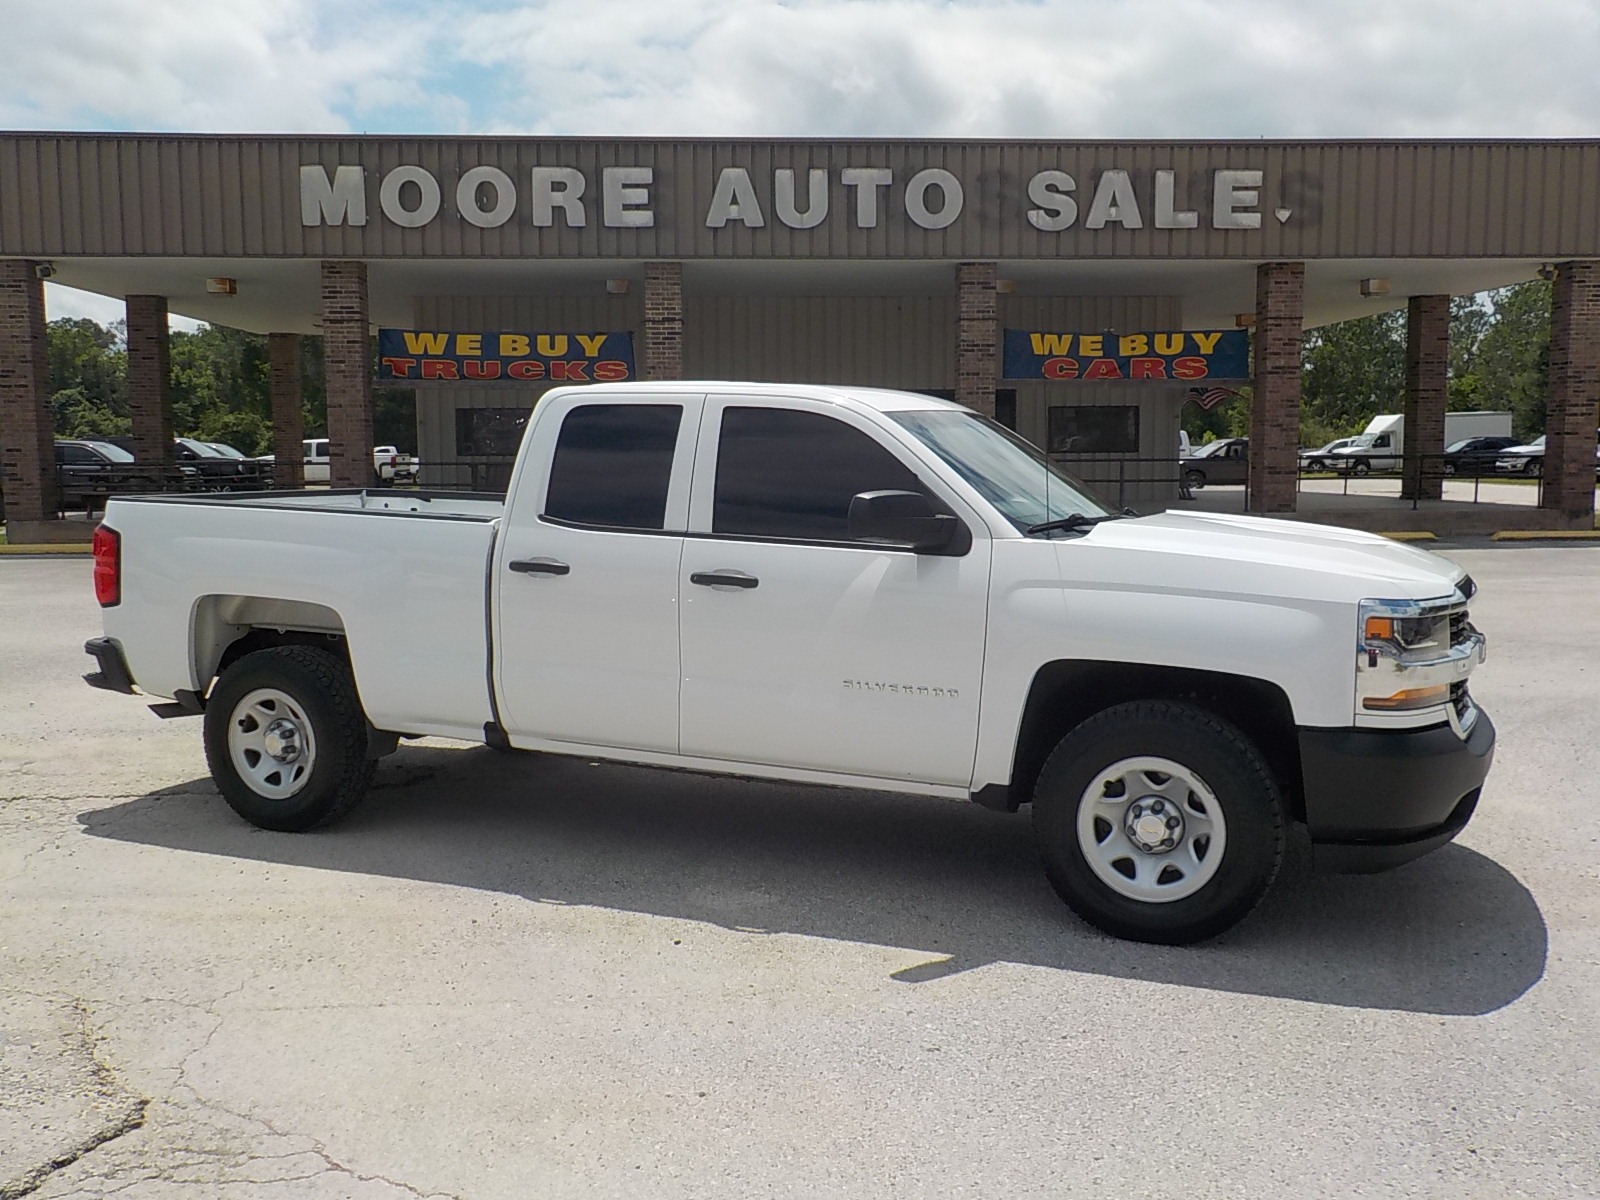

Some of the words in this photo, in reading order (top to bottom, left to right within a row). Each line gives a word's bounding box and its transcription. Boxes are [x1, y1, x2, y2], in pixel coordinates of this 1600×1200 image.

[300, 164, 655, 229] MOORE
[705, 167, 964, 230] AUTO
[403, 332, 483, 356] WE
[499, 334, 608, 357] BUY
[1029, 333, 1104, 357] WE
[1118, 332, 1223, 357] BUY
[381, 357, 630, 381] TRUCKS
[1042, 356, 1209, 380] CARS
[842, 679, 960, 699] SILVERADO
